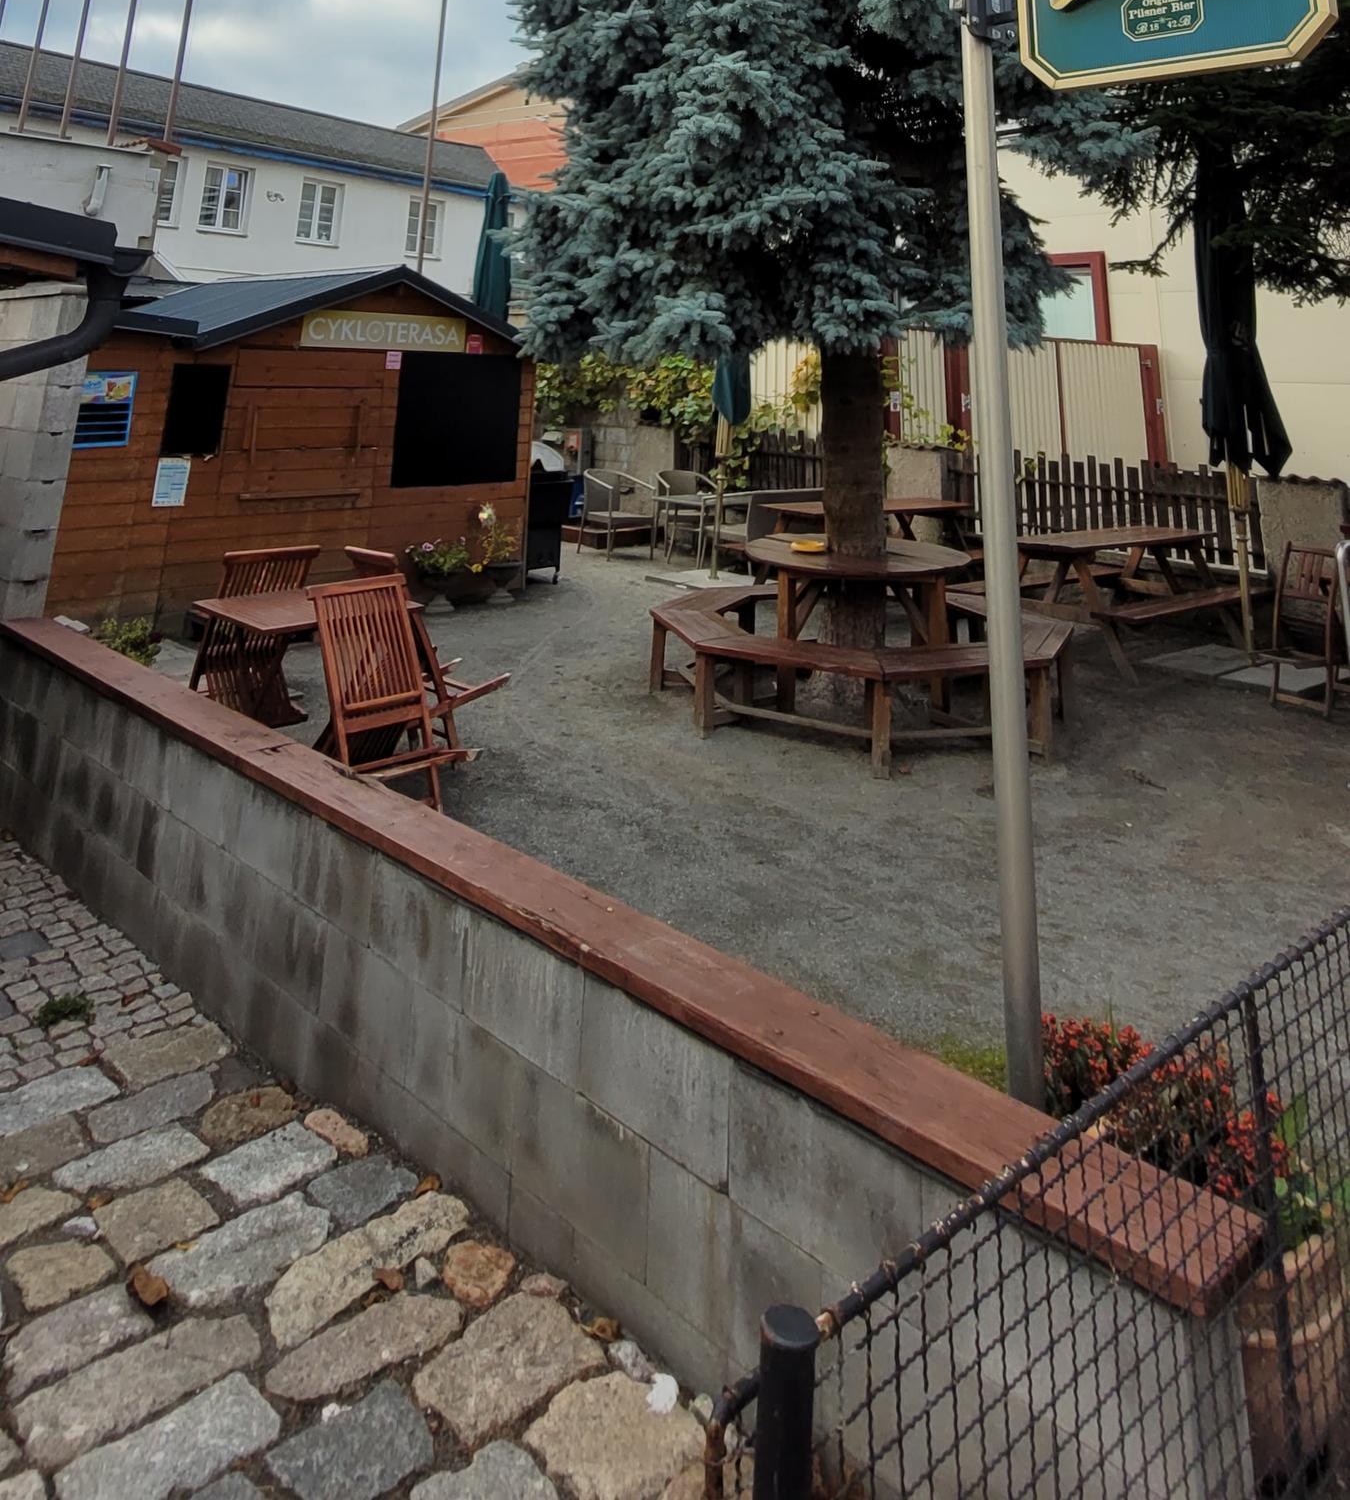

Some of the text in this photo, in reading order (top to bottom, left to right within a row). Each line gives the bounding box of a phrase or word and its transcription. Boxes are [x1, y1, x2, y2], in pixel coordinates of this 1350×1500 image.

[1128, 1, 1195, 20] Pilsner Bier
[308, 317, 460, 346] CYKLOTERASA
